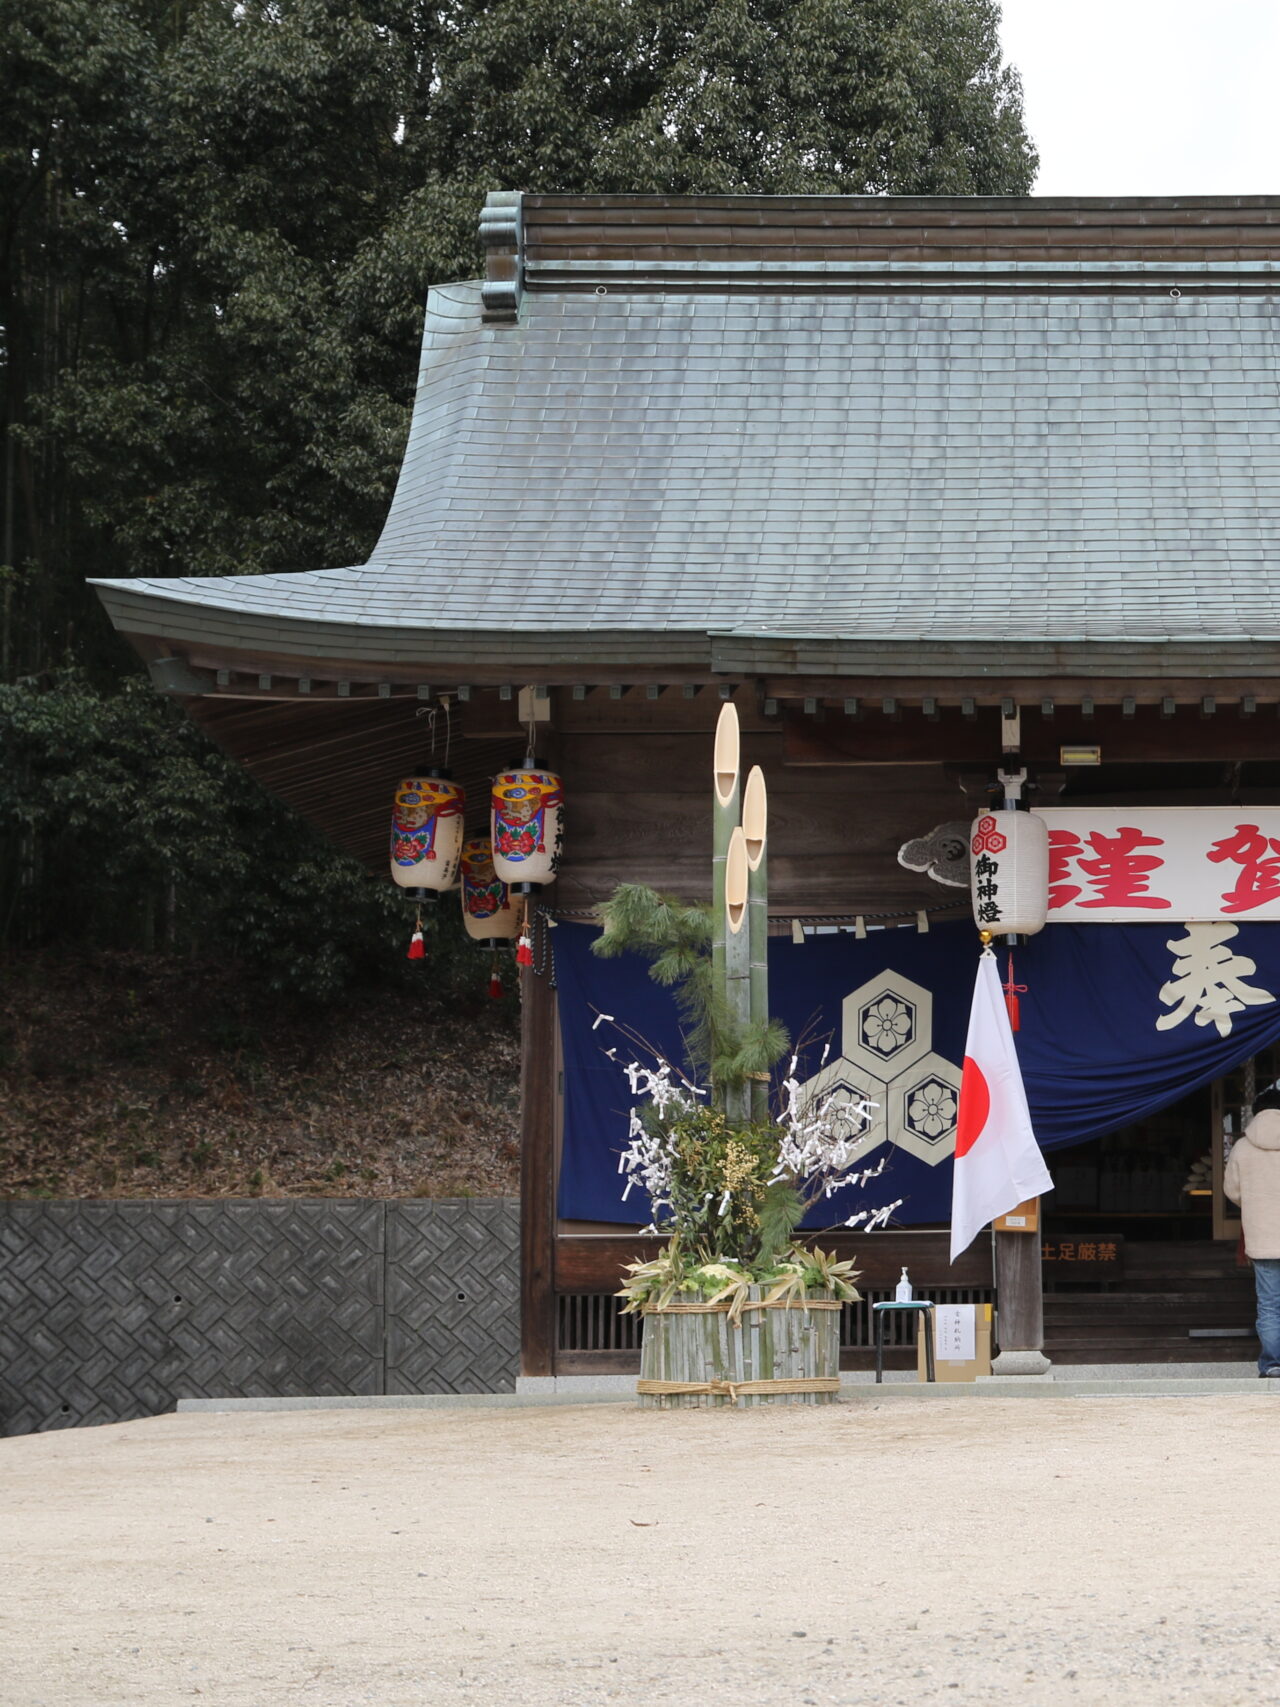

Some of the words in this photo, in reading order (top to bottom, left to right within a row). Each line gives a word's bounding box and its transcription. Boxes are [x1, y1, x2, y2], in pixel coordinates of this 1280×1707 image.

[975, 853, 1003, 924] 御神燈
[1041, 1242, 1116, 1262] 土足厳禁
